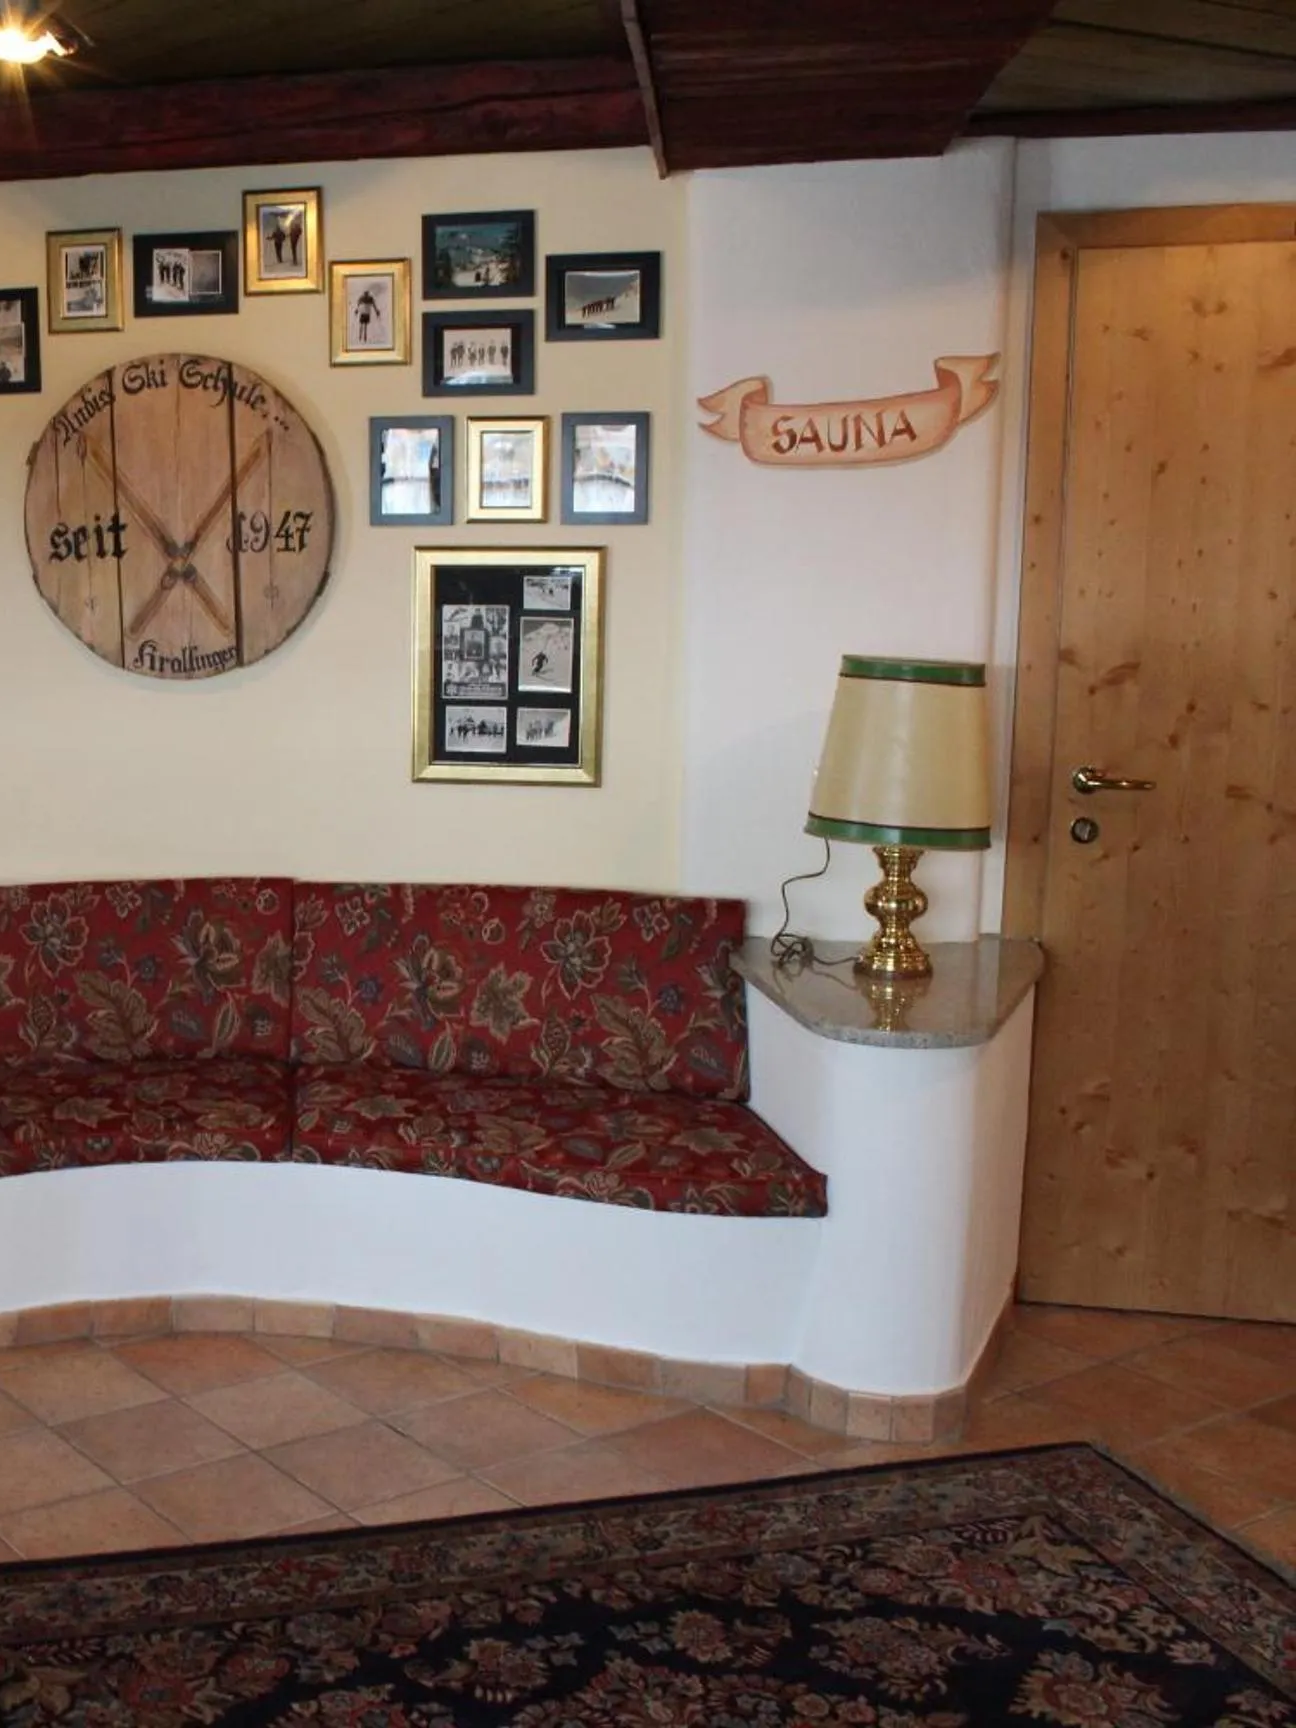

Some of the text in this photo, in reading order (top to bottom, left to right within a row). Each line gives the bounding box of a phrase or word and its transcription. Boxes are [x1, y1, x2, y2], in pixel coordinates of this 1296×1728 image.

[122, 359, 168, 395] Ski
[771, 409, 917, 455] SAUNA
[48, 511, 313, 563] seit 1947
